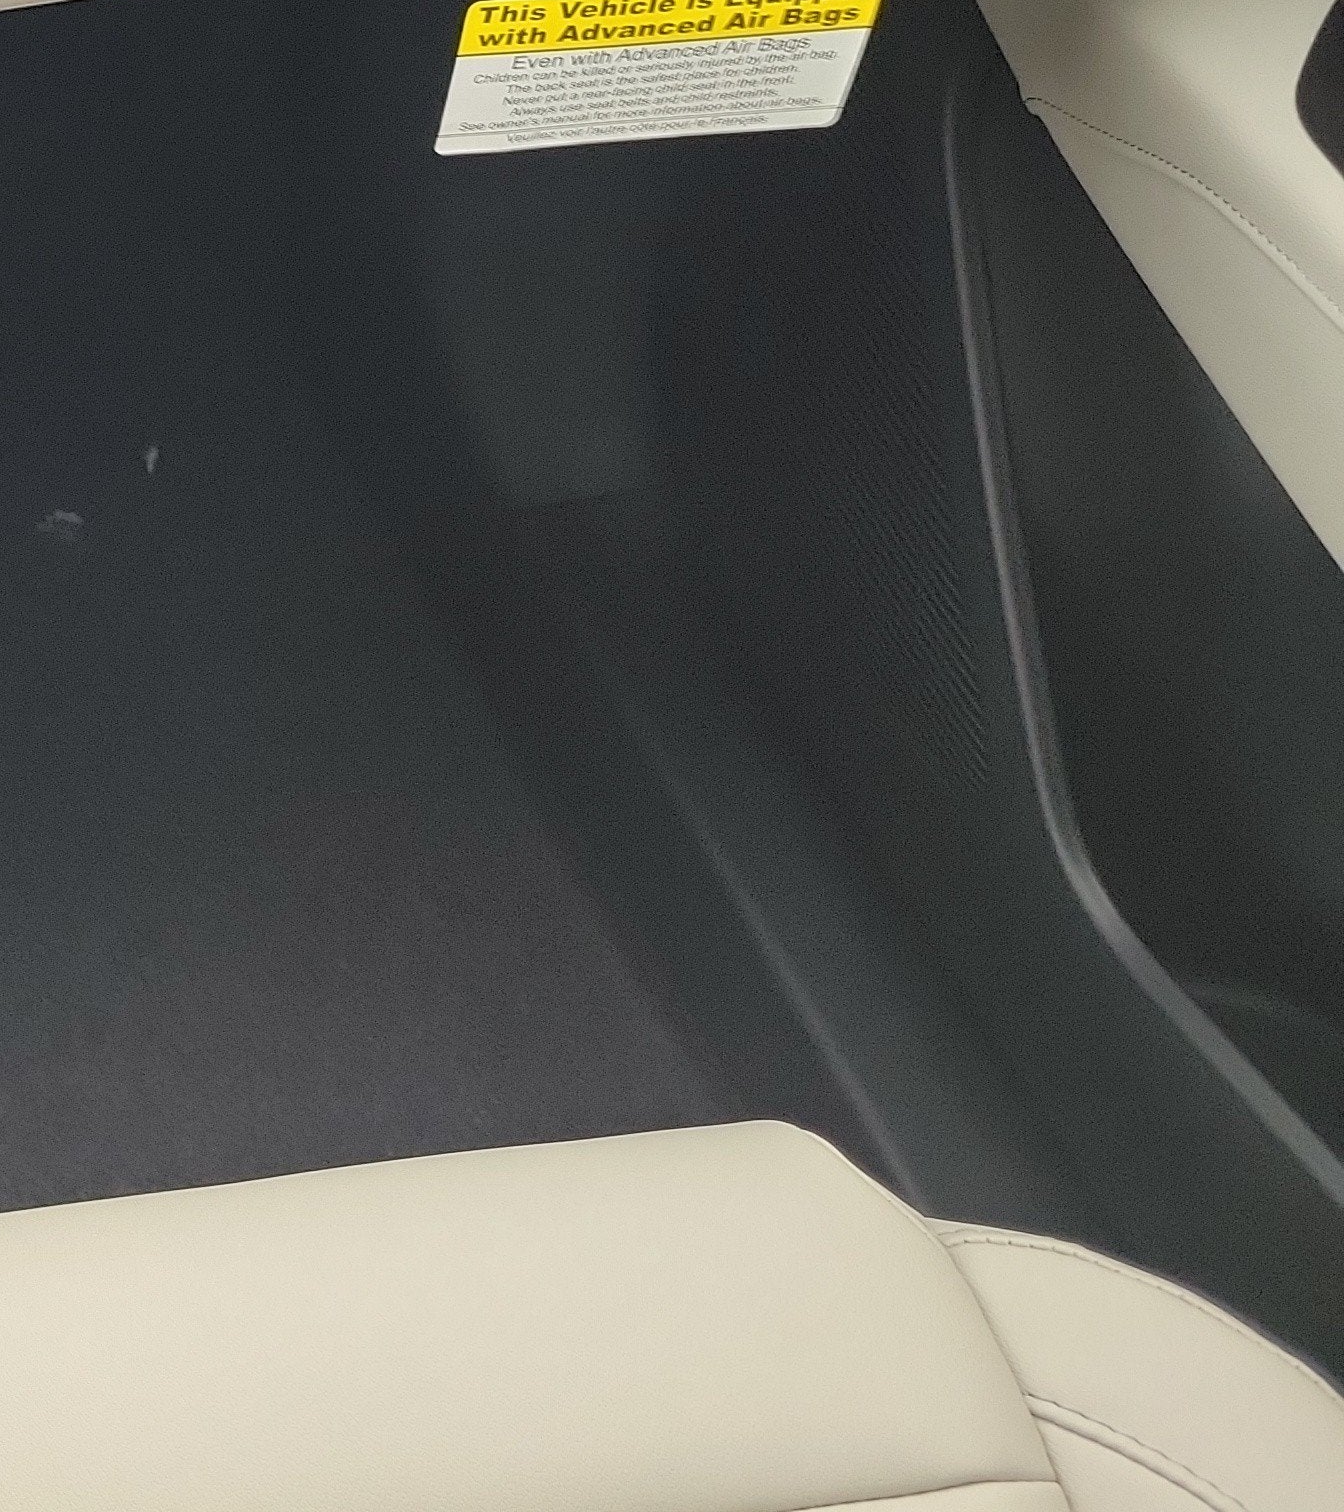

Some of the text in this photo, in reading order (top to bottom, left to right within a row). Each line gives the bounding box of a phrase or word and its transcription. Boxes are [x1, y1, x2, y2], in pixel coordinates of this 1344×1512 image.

[480, 6, 547, 25] This
[479, 6, 861, 47] with Advanced Air Bags
[511, 37, 811, 70] Even with Advanced Air Bags
[473, 73, 529, 84] Children
[532, 72, 556, 80] can
[561, 69, 578, 79] be
[581, 66, 614, 76] killed
[618, 66, 632, 74] or
[506, 84, 531, 94] The
[535, 82, 565, 92] back
[569, 79, 599, 89] seat
[502, 95, 542, 106] Never
[509, 106, 556, 118] Always
[559, 104, 583, 112] use
